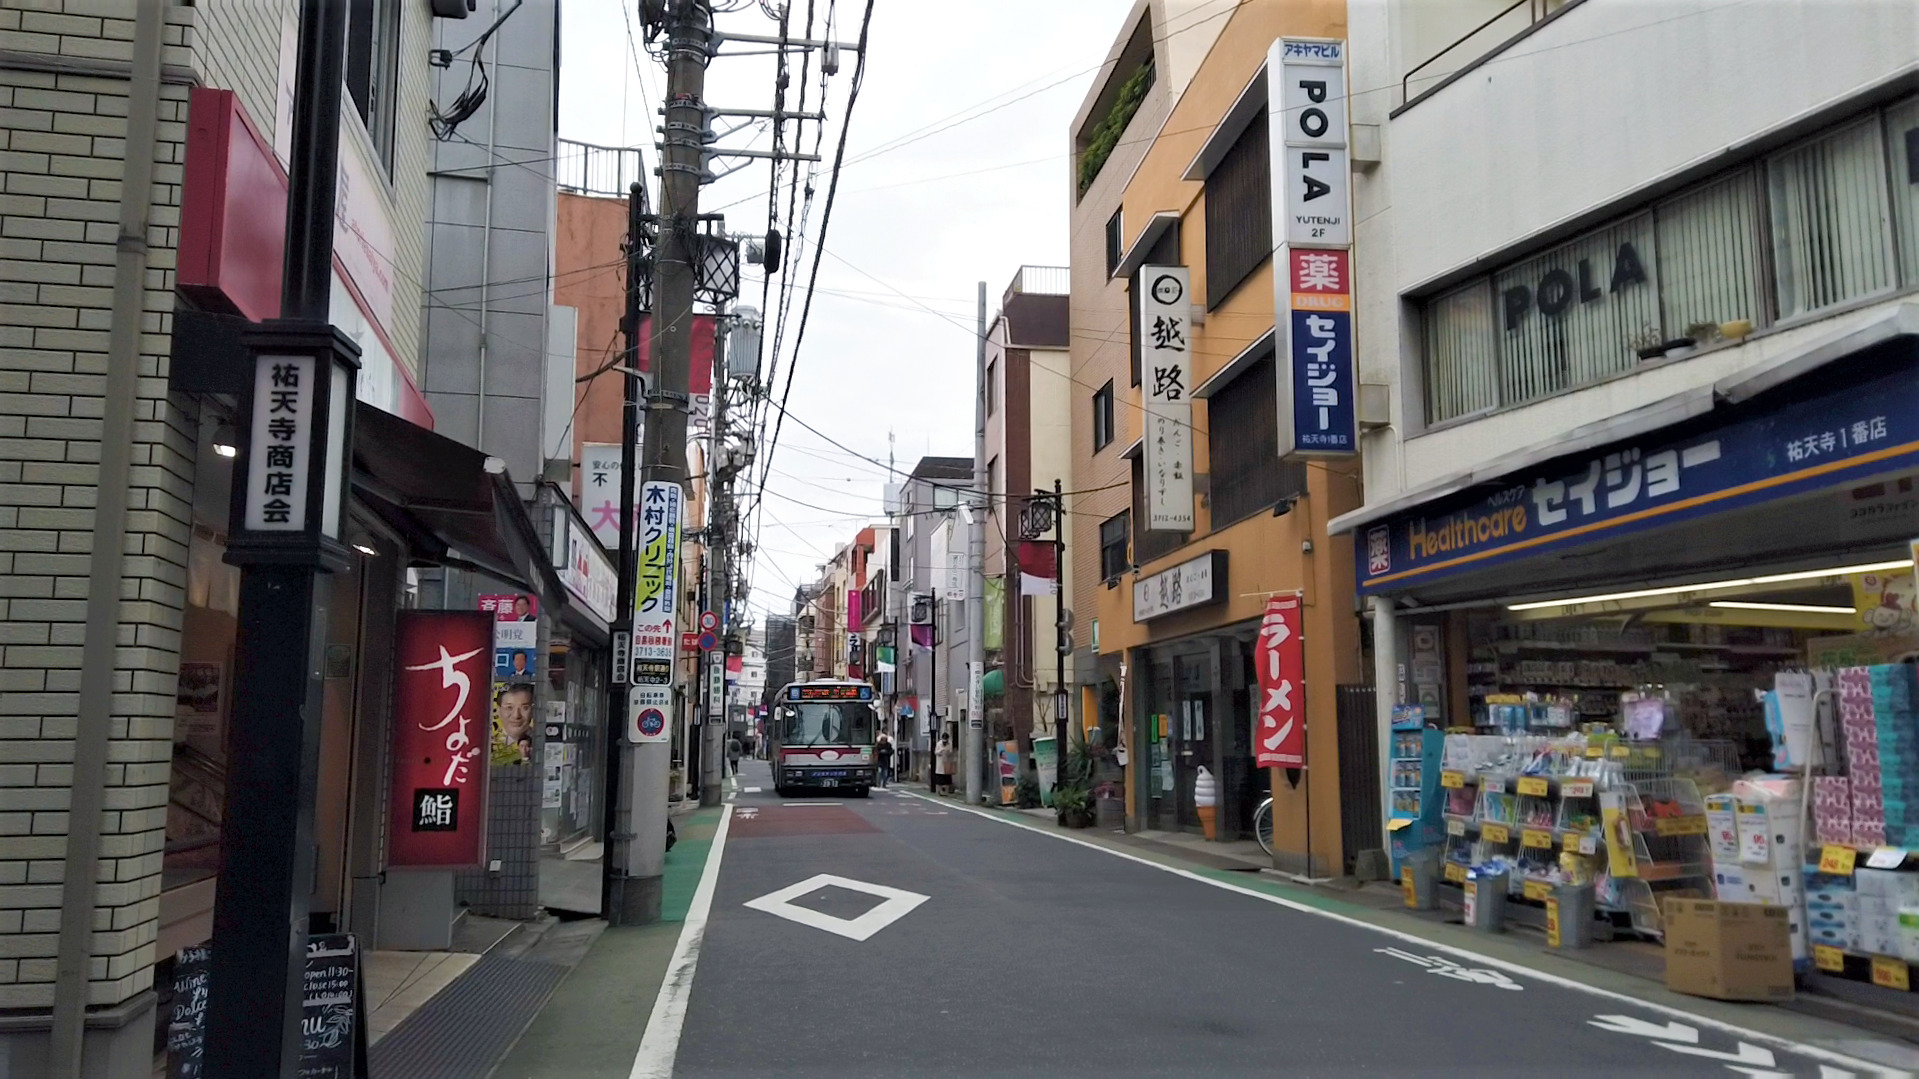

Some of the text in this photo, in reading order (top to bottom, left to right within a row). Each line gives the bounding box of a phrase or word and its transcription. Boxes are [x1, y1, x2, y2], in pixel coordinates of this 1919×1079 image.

[1284, 43, 1340, 58] アキヤマビル
[1299, 80, 1331, 202] POLA
[1296, 215, 1340, 225] YUTENJI
[1311, 228, 1325, 237] 2F
[1296, 297, 1344, 308] DRUG
[1299, 253, 1340, 290] 薬
[1505, 242, 1647, 331] POLA
[1151, 315, 1185, 402] 越路
[1306, 314, 1338, 430] セイジョー
[263, 363, 300, 523] 祐天寺商店会
[1787, 416, 1887, 462] 祐天寺1番店
[1531, 440, 1721, 526] セイジョー
[642, 485, 666, 612] 木村クリニック
[1408, 505, 1527, 560] Healthcare
[1261, 613, 1294, 751] ラーメン
[419, 794, 453, 826] 鮨
